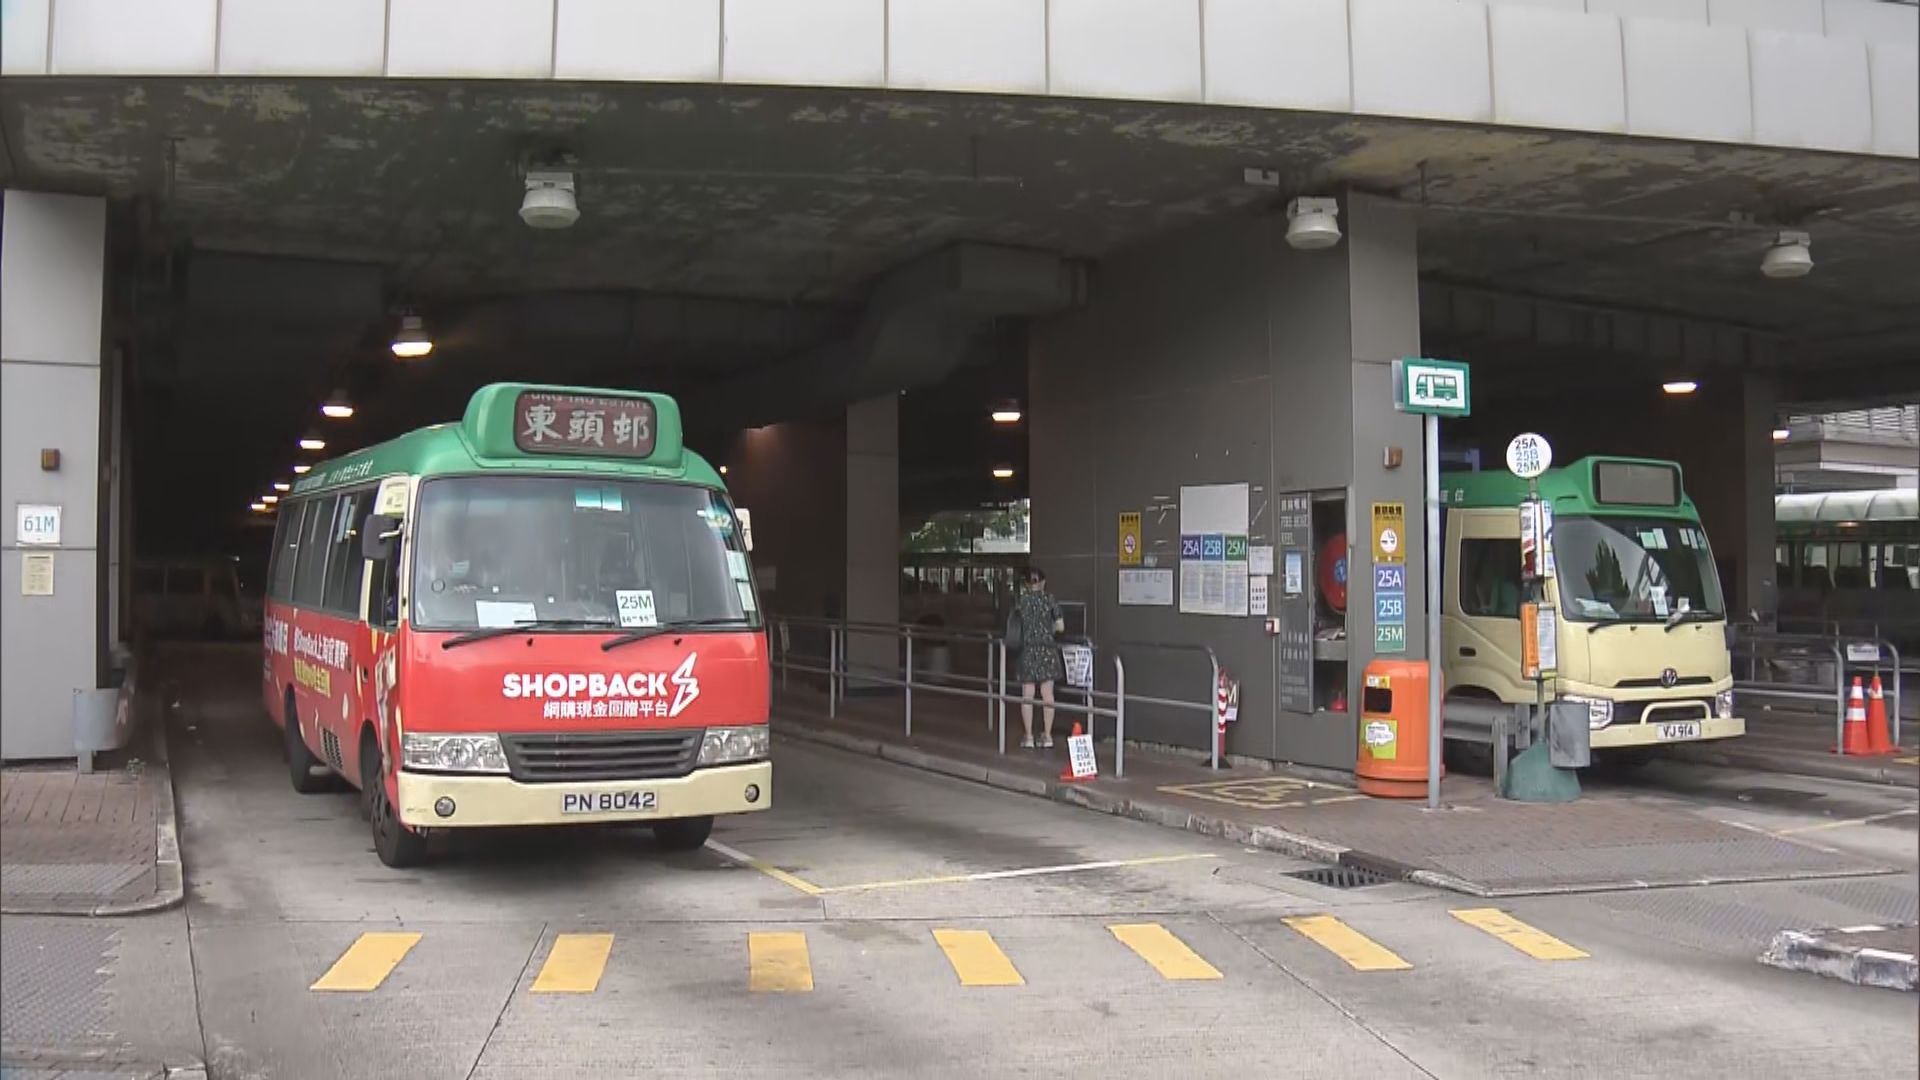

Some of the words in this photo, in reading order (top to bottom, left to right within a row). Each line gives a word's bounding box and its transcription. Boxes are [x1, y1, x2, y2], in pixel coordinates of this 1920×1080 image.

[522, 404, 649, 448] 東頭邨
[1514, 438, 1538, 449] 25A
[1516, 461, 1540, 473] 25M
[24, 516, 55, 532] 61M
[1183, 540, 1199, 555] 25A
[1204, 539, 1221, 555] 25B
[1227, 540, 1245, 555] 25M
[1378, 570, 1401, 587] 25A
[620, 595, 652, 609] 25M
[1379, 600, 1402, 616] 25B
[1377, 627, 1403, 642] 25M
[502, 672, 668, 697] SHOPBACK
[1663, 725, 1677, 738] VJ
[1678, 723, 1694, 737] 914
[564, 794, 592, 811] PN
[599, 792, 655, 810] 8042
